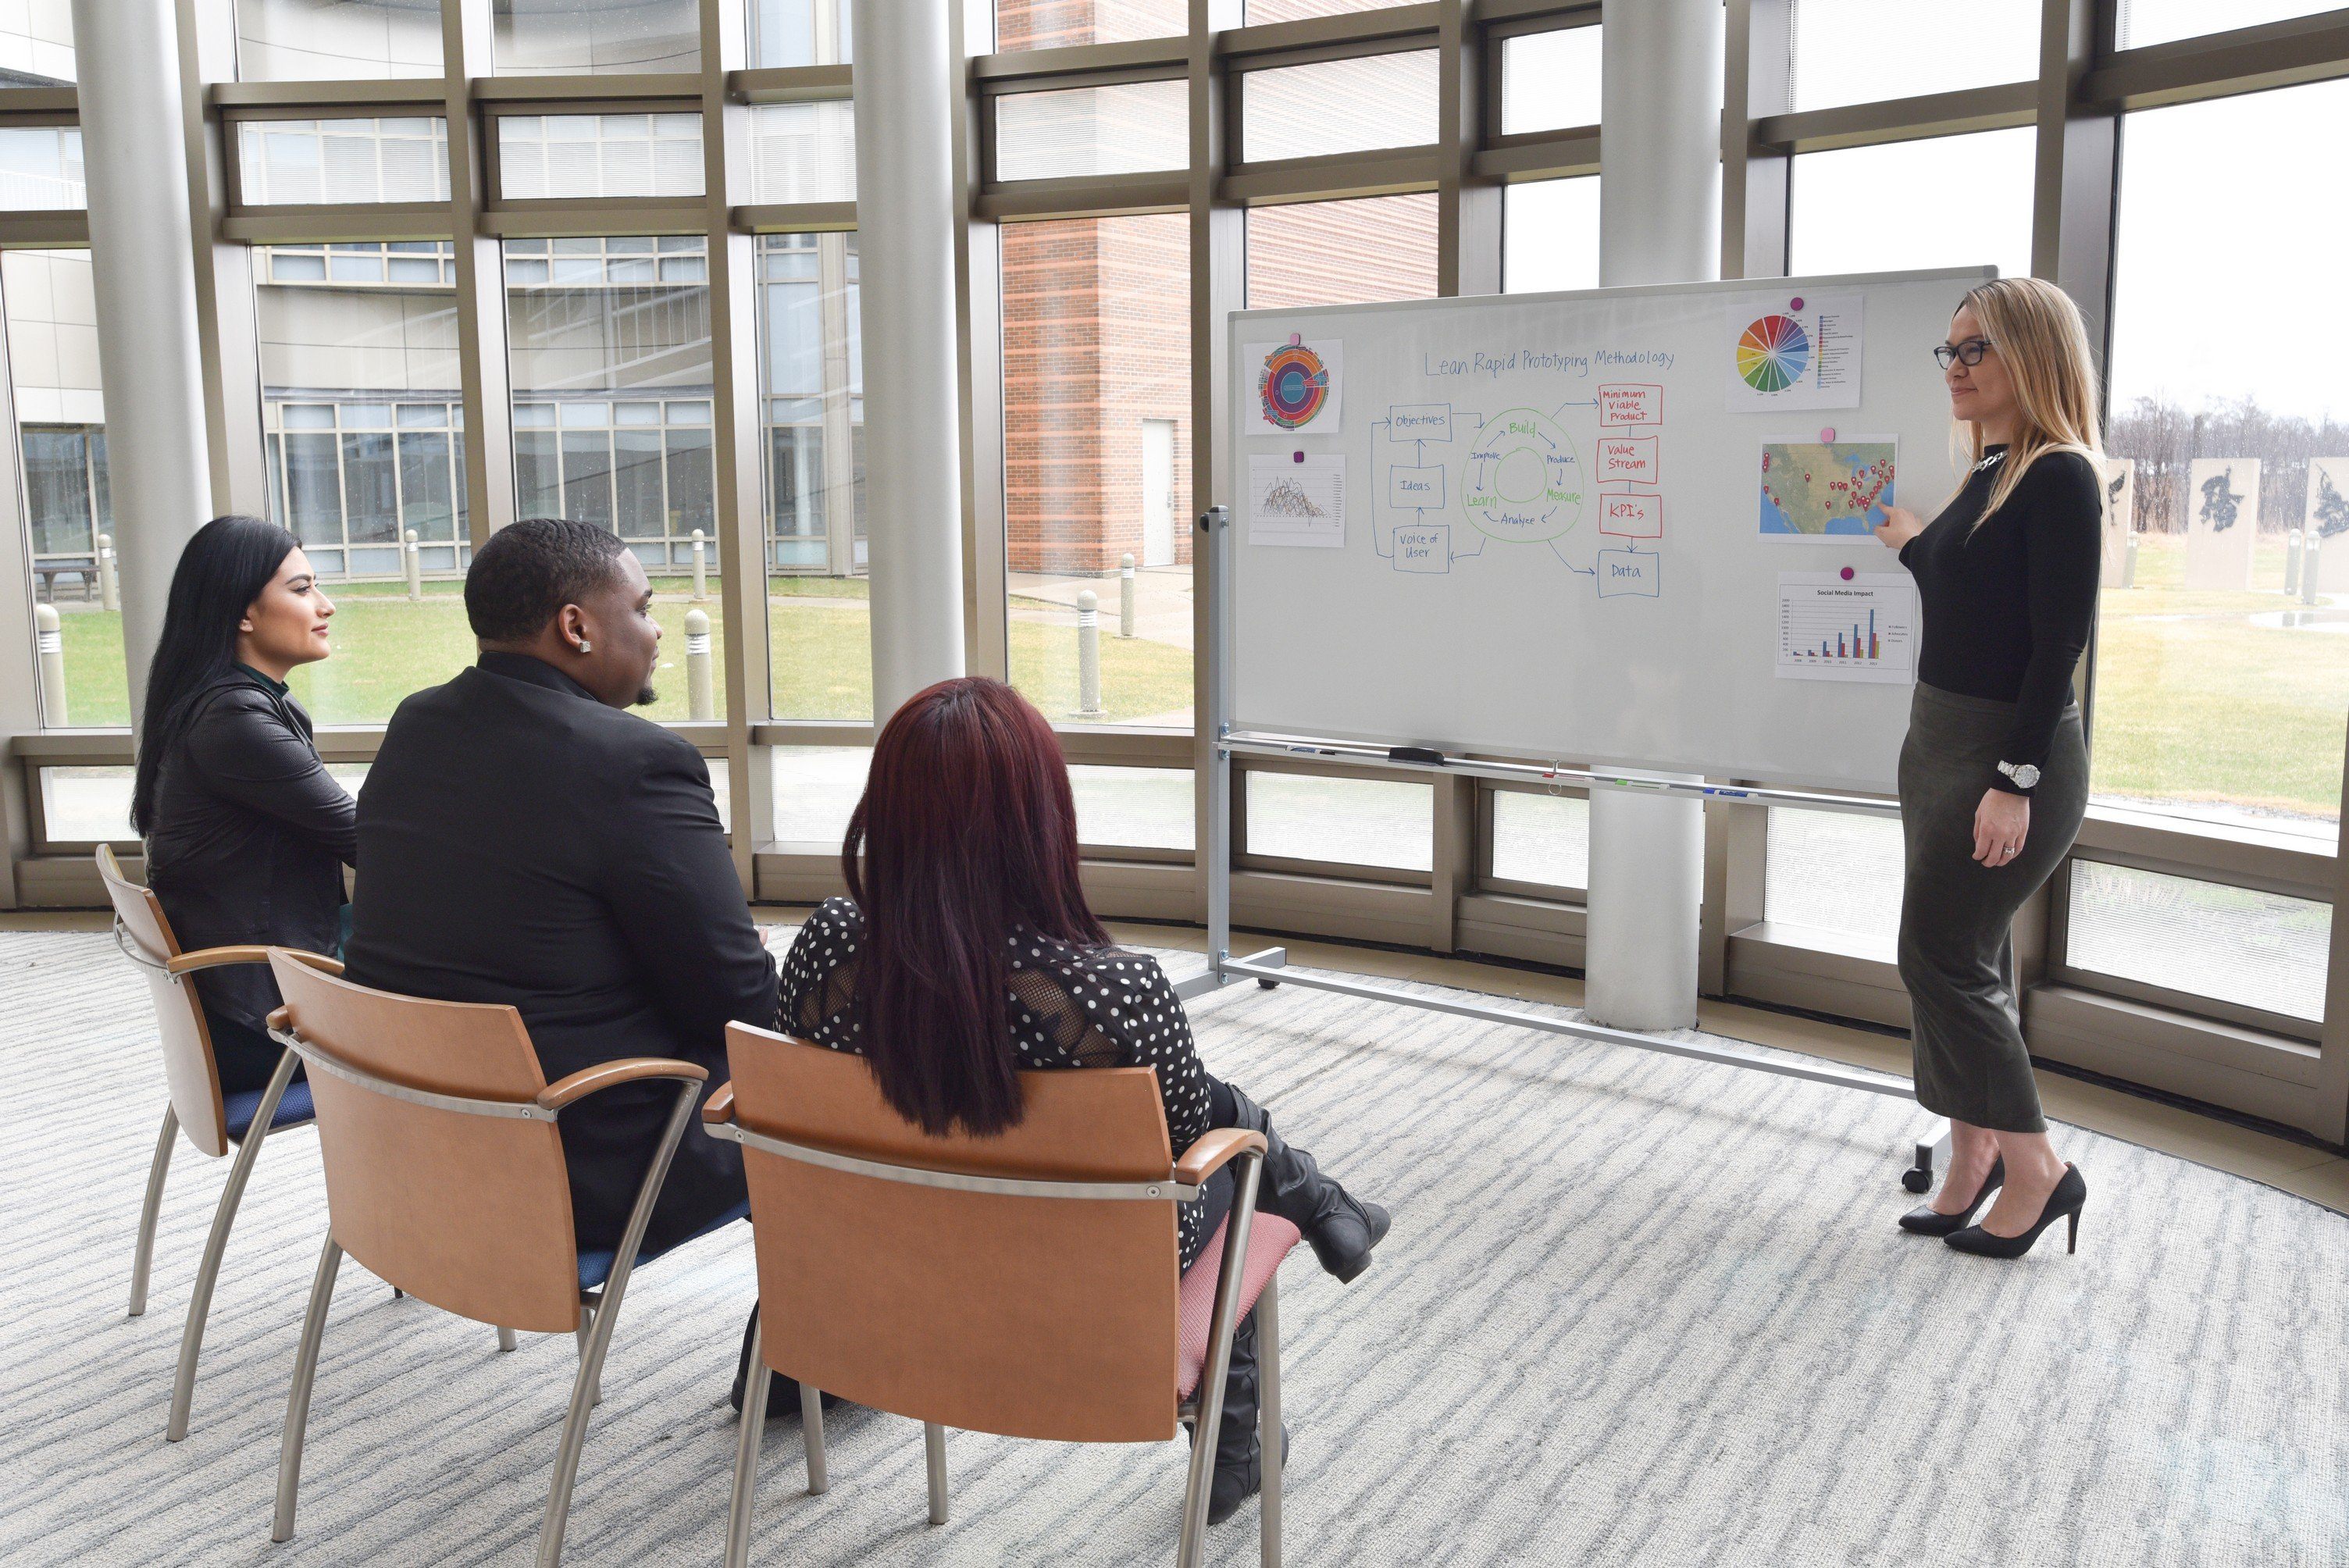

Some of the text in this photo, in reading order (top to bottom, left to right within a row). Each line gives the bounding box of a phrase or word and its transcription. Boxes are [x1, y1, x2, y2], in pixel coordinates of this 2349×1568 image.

[1425, 350, 1674, 378] Lean Rapid Prototyping Methodology
[1603, 389, 1646, 399] Minimum
[1609, 400, 1641, 410] Viable
[1395, 412, 1445, 427] Objectives
[1610, 411, 1648, 422] Product
[1510, 419, 1536, 438] Build
[1608, 444, 1634, 457] Value
[1470, 452, 1501, 462] Improve
[1547, 454, 1576, 465] Produce
[1608, 458, 1646, 470] Stream
[1399, 480, 1431, 491] Ideas
[1467, 494, 1497, 509] Learn
[1546, 487, 1581, 505] Measure
[1609, 502, 1645, 520] KPI's
[1500, 512, 1535, 528] Analyze
[1400, 533, 1439, 544] Voice of
[1406, 547, 1430, 558] User
[1612, 564, 1641, 578] Data
